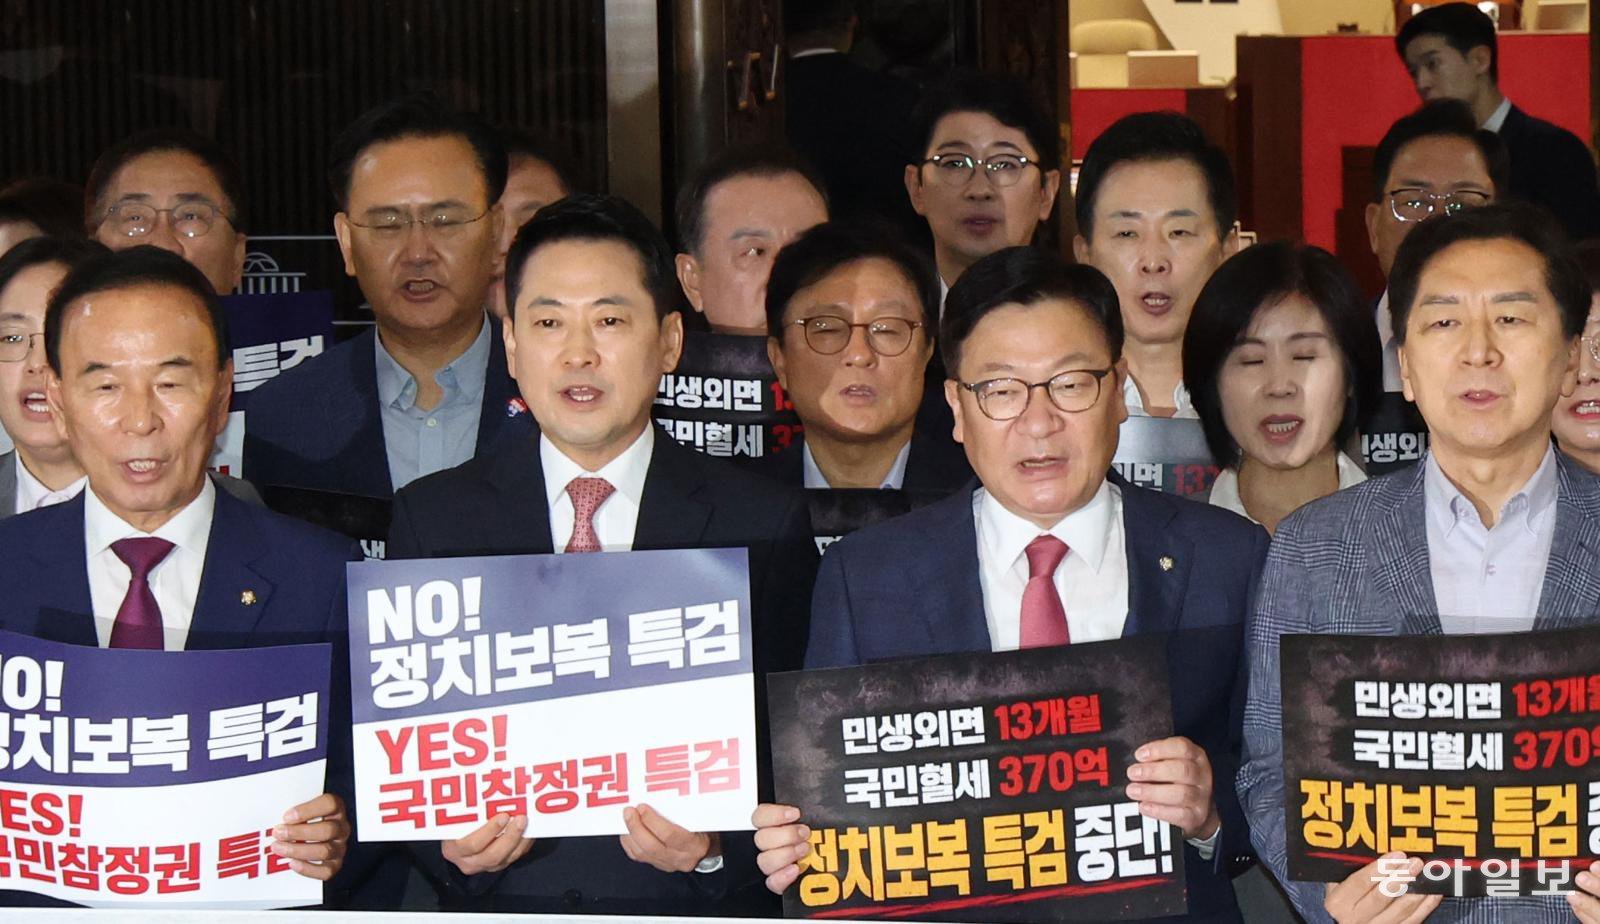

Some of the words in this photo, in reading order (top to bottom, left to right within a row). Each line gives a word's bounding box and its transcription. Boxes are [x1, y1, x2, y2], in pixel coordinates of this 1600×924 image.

[1172, 463, 1221, 496] 13
[367, 576, 482, 644] NO!
[0, 654, 64, 712] O!
[369, 618, 611, 709] 정치보복
[628, 600, 740, 669] 특검
[841, 706, 985, 755] 민생외면
[993, 694, 1101, 741] 13개월
[1354, 681, 1501, 719] 민생외면
[0, 712, 190, 774] 치보복
[207, 692, 319, 762] 특검
[375, 714, 508, 775] YES!
[1353, 729, 1503, 771] 국민혈세
[379, 753, 629, 828] 국민참정권
[644, 738, 741, 797] 특검
[844, 759, 990, 809] 국민혈세
[998, 747, 1109, 797] 370억
[1300, 779, 1478, 857] 정치보복
[1492, 783, 1578, 858] 특검
[0, 835, 200, 895] 민참정권
[798, 816, 970, 907] 정치보복
[983, 809, 1068, 890] 특검
[1074, 801, 1174, 882] 중단!
